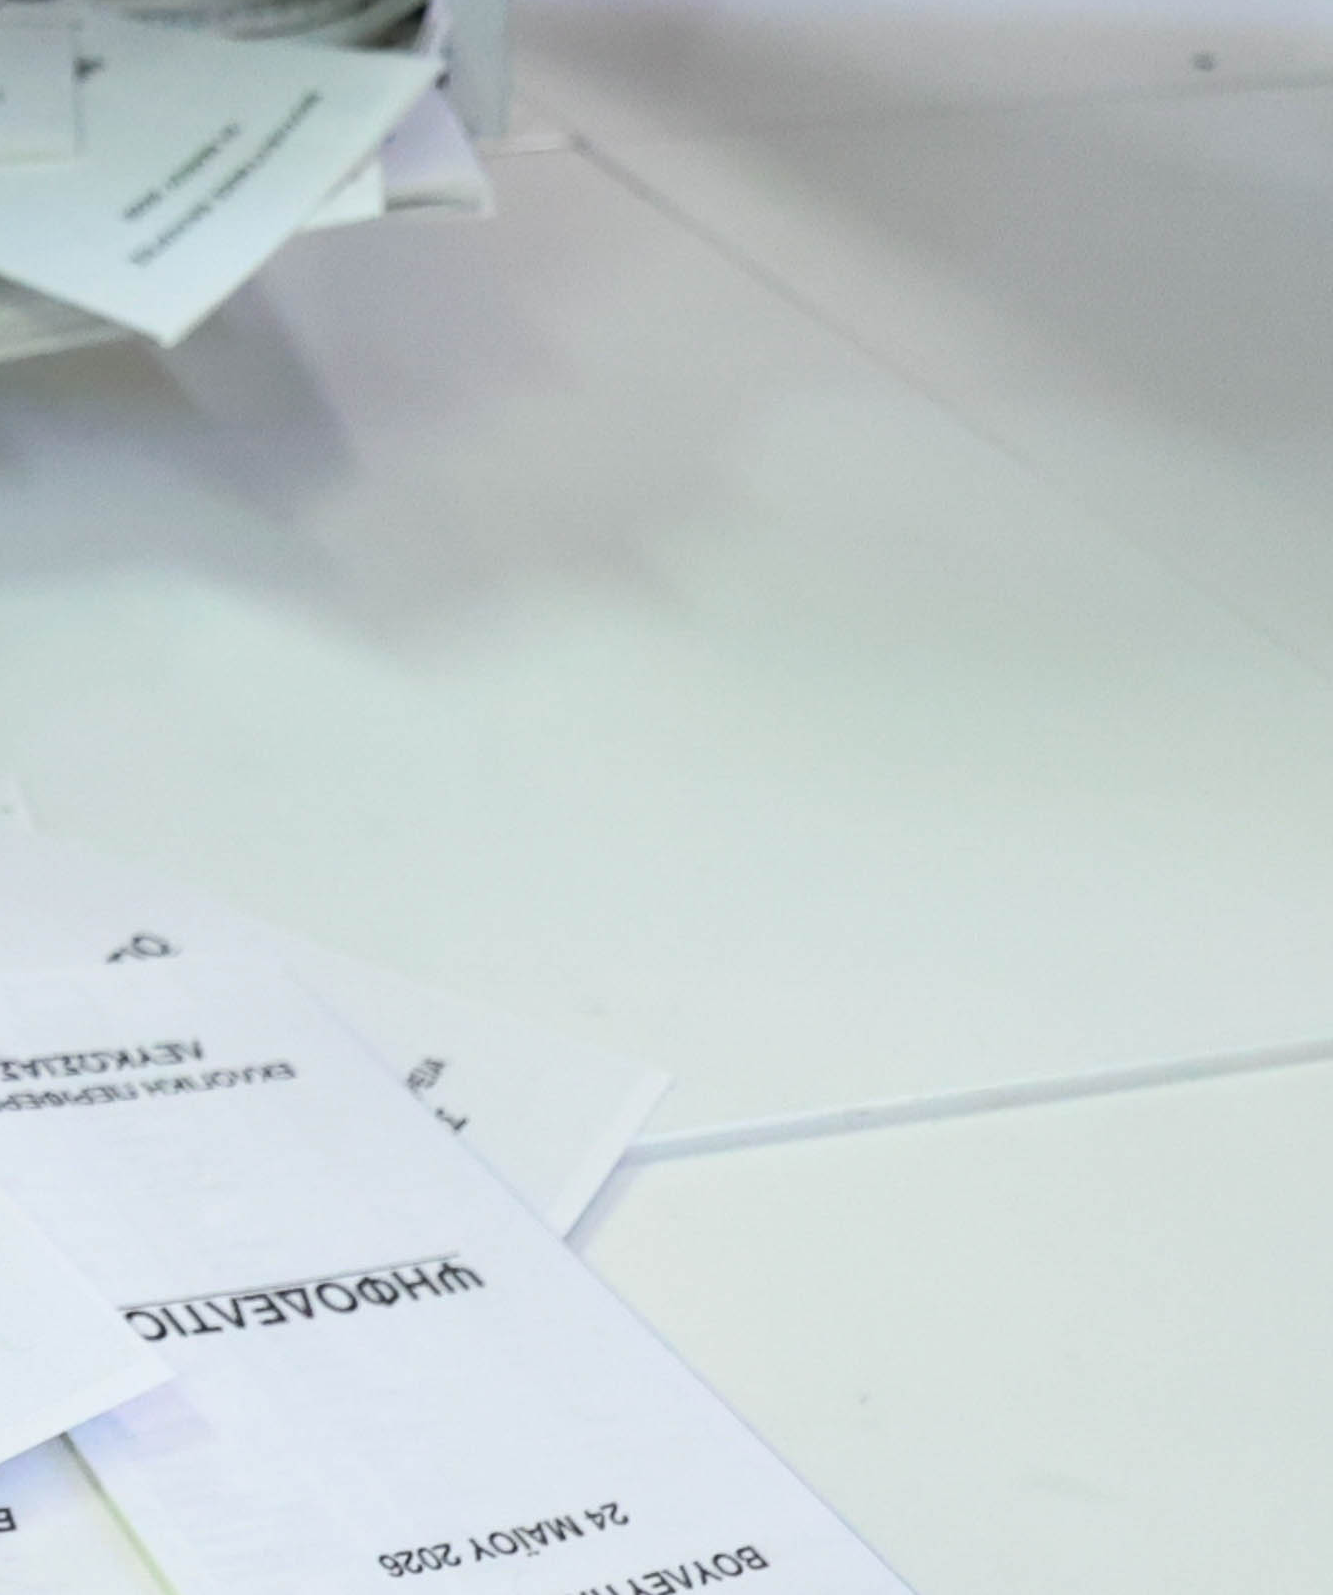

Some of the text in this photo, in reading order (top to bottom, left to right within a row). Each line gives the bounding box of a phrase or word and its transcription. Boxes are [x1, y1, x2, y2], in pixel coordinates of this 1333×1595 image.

[378, 1502, 630, 1579] 24 ΜΑΪΟΥ 2026
